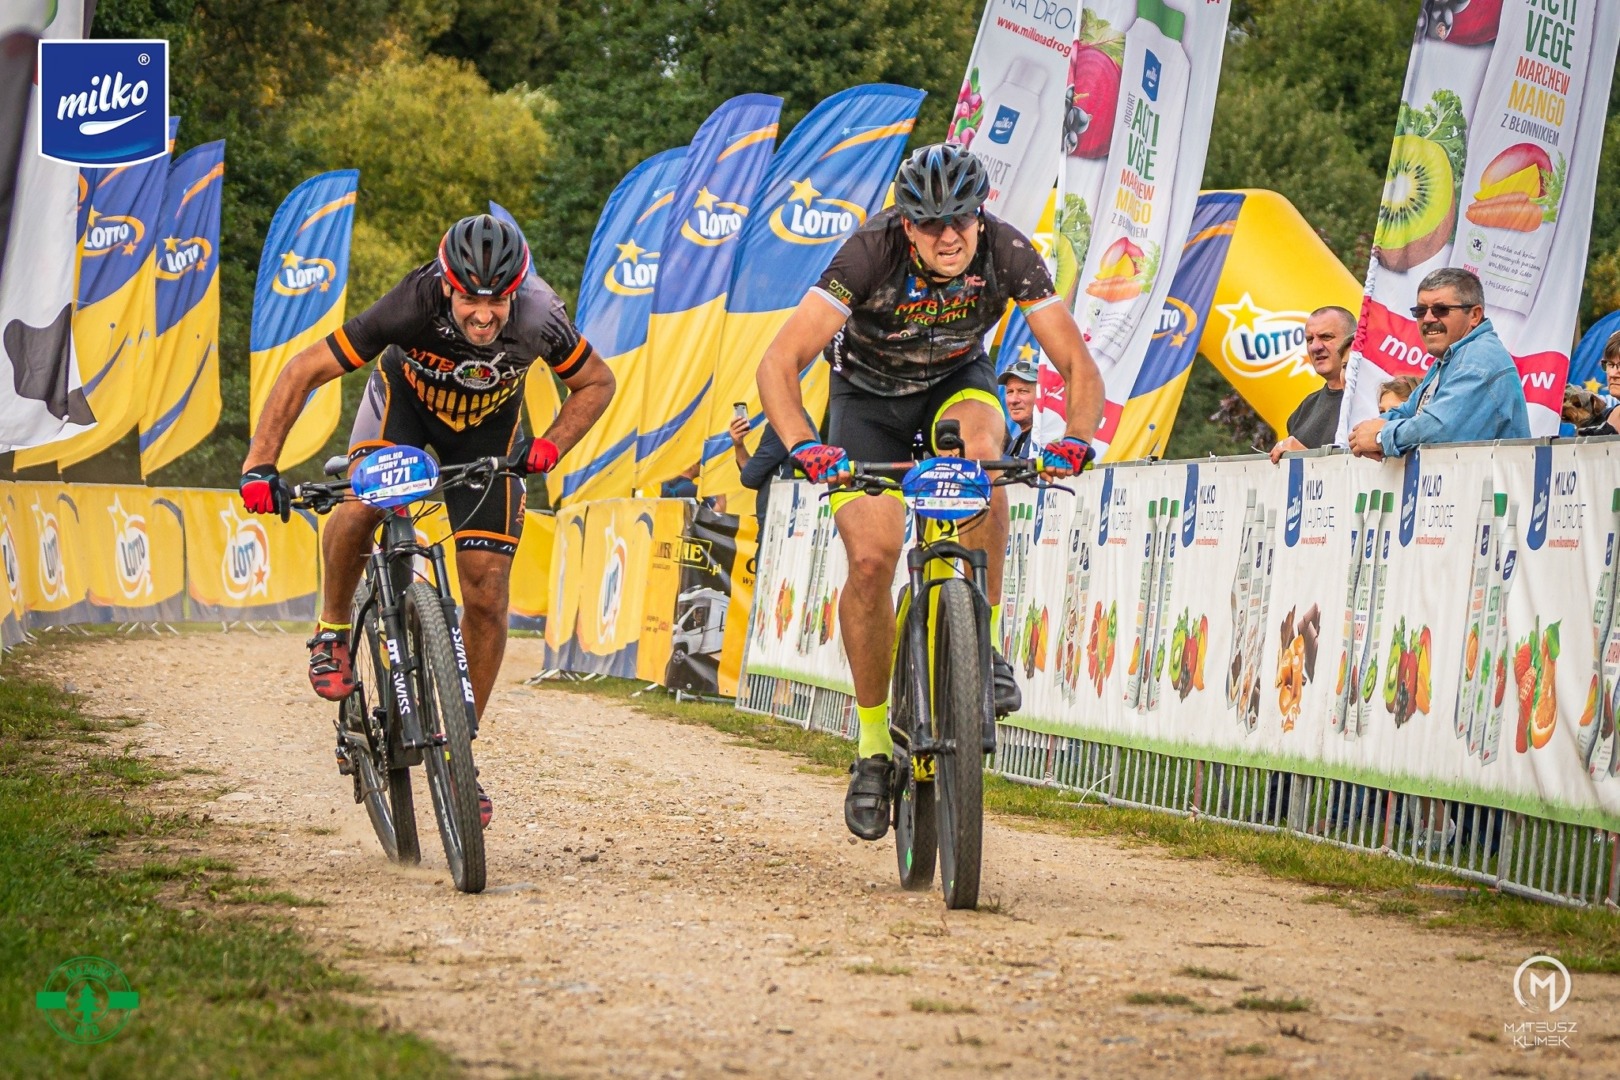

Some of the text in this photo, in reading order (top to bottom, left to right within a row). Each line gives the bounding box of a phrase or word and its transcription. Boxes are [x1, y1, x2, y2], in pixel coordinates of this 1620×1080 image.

[1034, 0, 1076, 32] DRO
[1526, 10, 1575, 69] VEGE
[1515, 56, 1570, 95] MARCHEW
[1123, 91, 1135, 127] JOGURT
[1507, 80, 1566, 126] MANGO
[1500, 114, 1559, 146] Z BŁONNIKIEM
[791, 205, 851, 235] LOTTO
[1116, 187, 1152, 224] MAGO
[84, 223, 129, 248] LOTTO
[698, 210, 741, 236] LOTTO
[166, 245, 199, 272] LOTO
[623, 262, 658, 286] LOT
[286, 265, 324, 288] LOTTO
[895, 300, 938, 315] MTB
[406, 348, 456, 371] MTB
[1241, 326, 1306, 361] LOTTO
[1378, 333, 1432, 372] moc
[381, 467, 411, 485] 471
[387, 639, 411, 715] DT SWISS
[452, 627, 475, 702] DT SWISS
